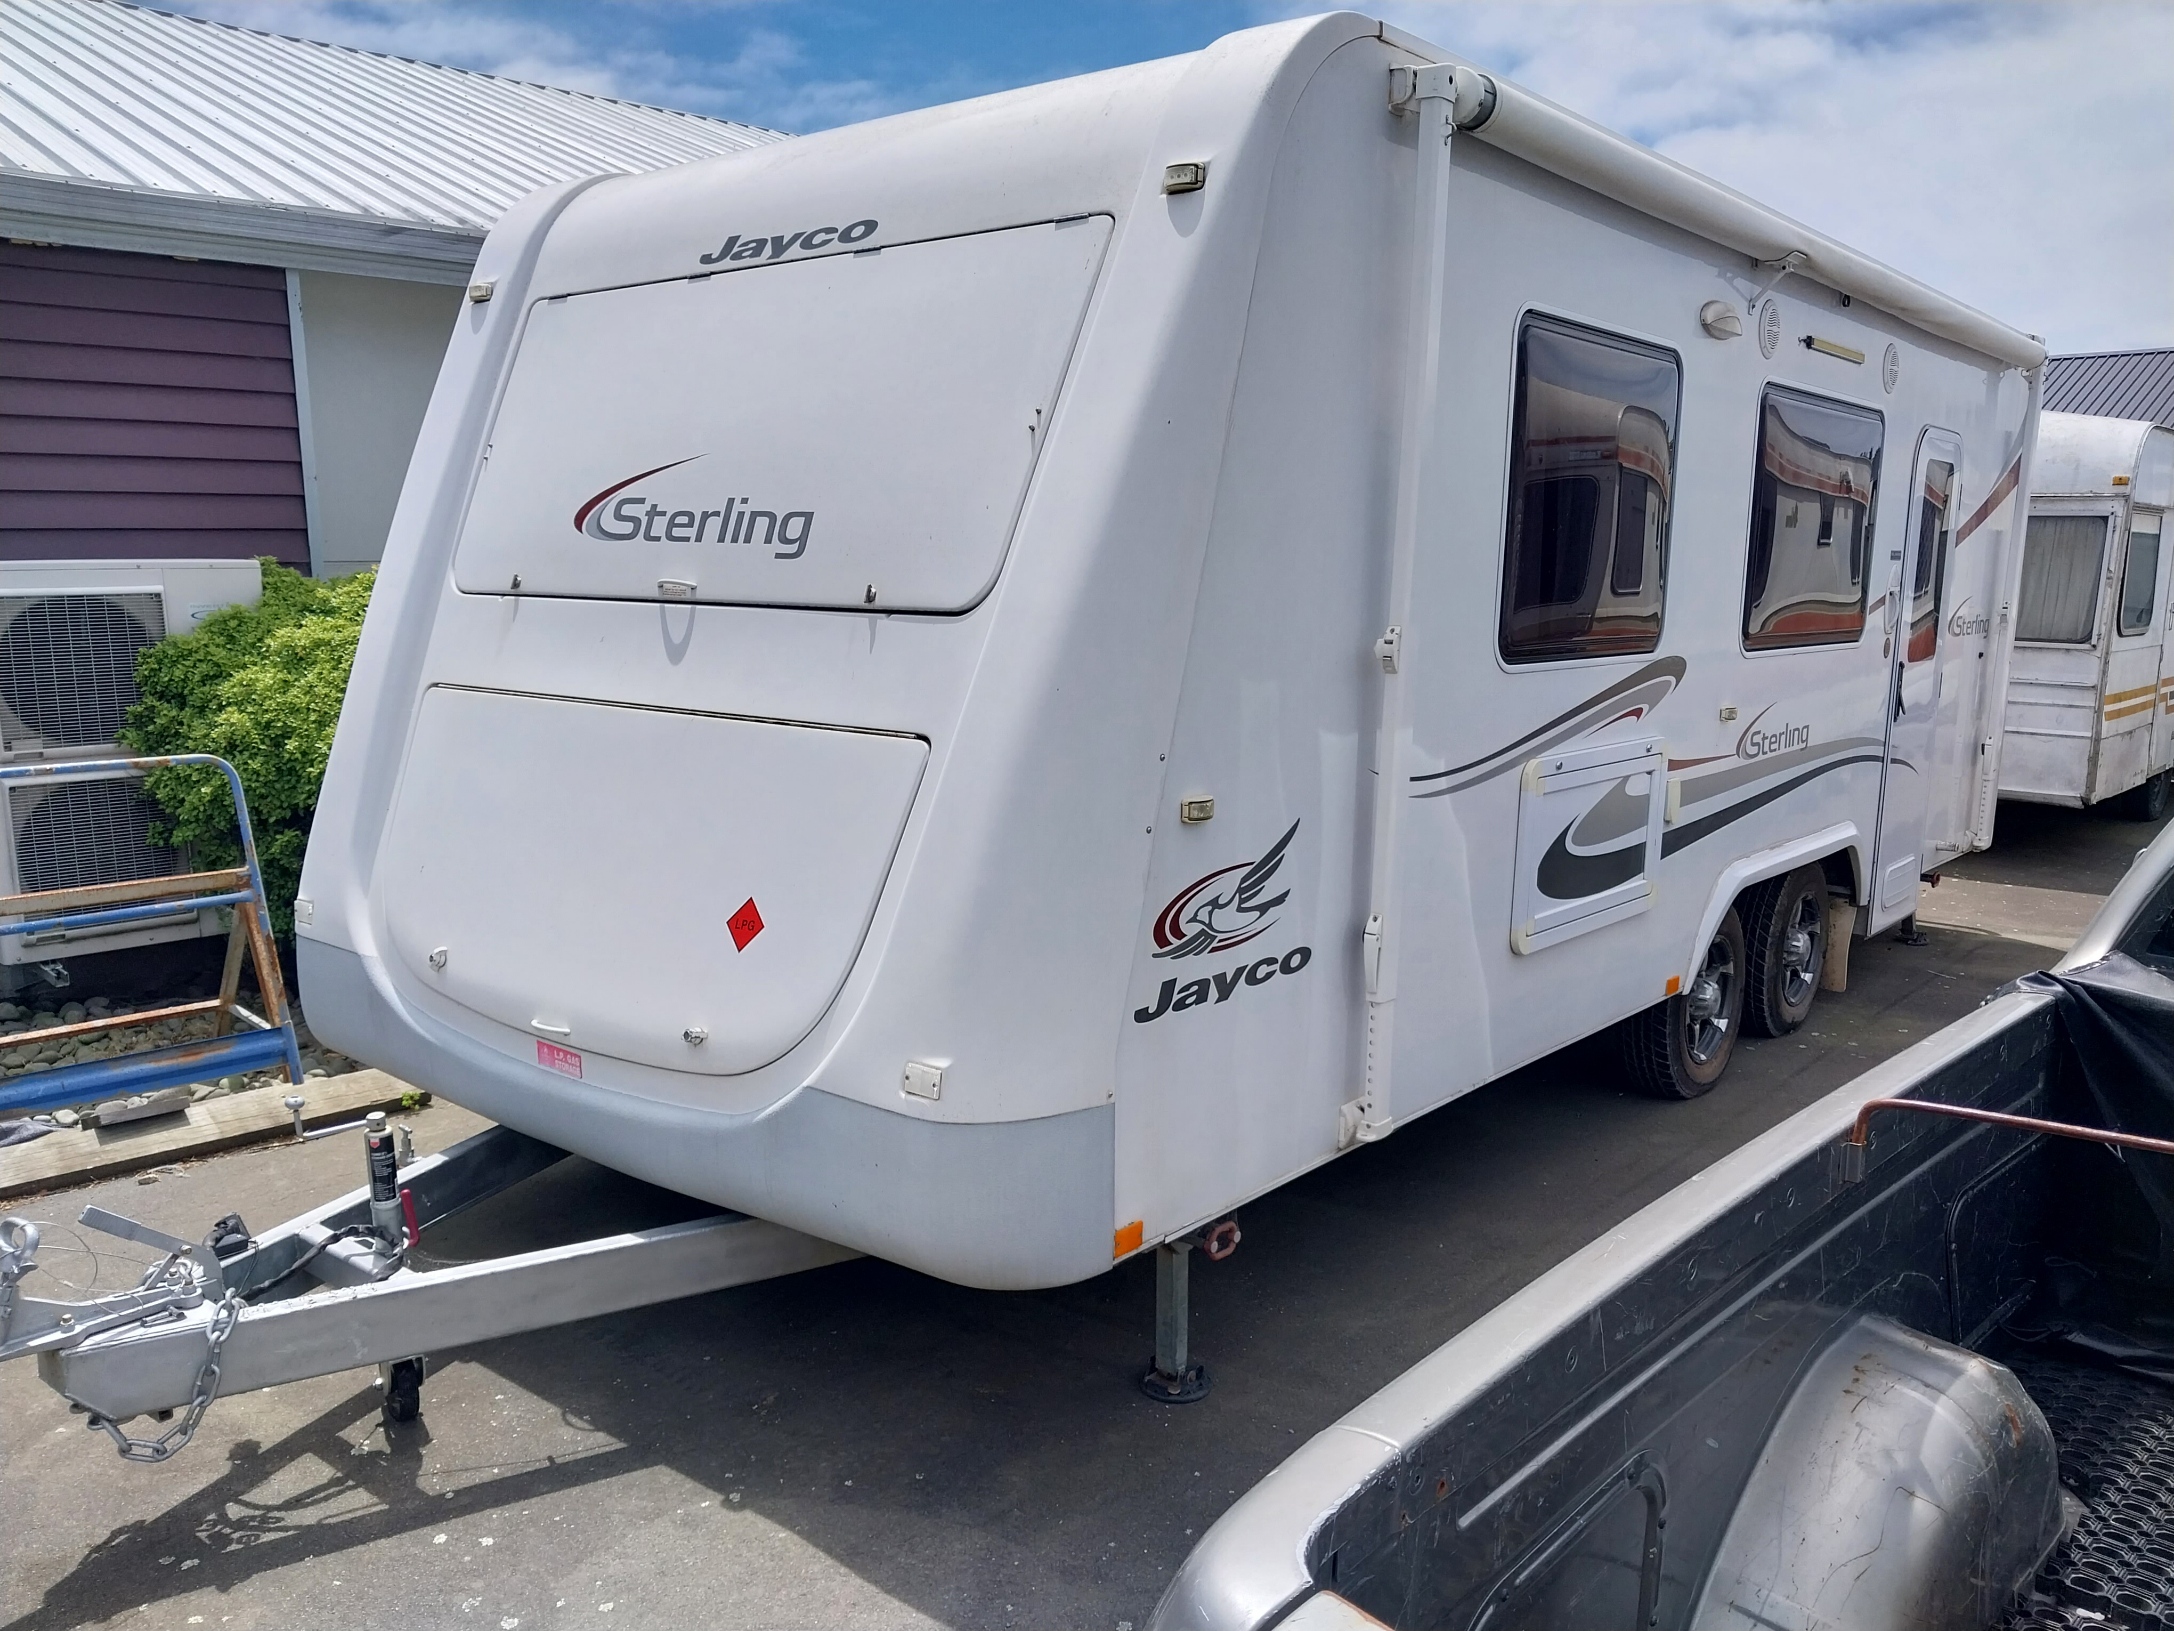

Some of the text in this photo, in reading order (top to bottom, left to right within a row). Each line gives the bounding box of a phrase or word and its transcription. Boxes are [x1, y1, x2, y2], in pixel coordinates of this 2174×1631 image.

[700, 219, 879, 265] Jayco
[597, 497, 815, 560] Sterling
[1953, 613, 1990, 639] Sterling
[1745, 722, 1810, 759] Sterling
[735, 918, 755, 931] LPG
[1133, 946, 1312, 1023] Jayco
[567, 1054, 580, 1066] GAS
